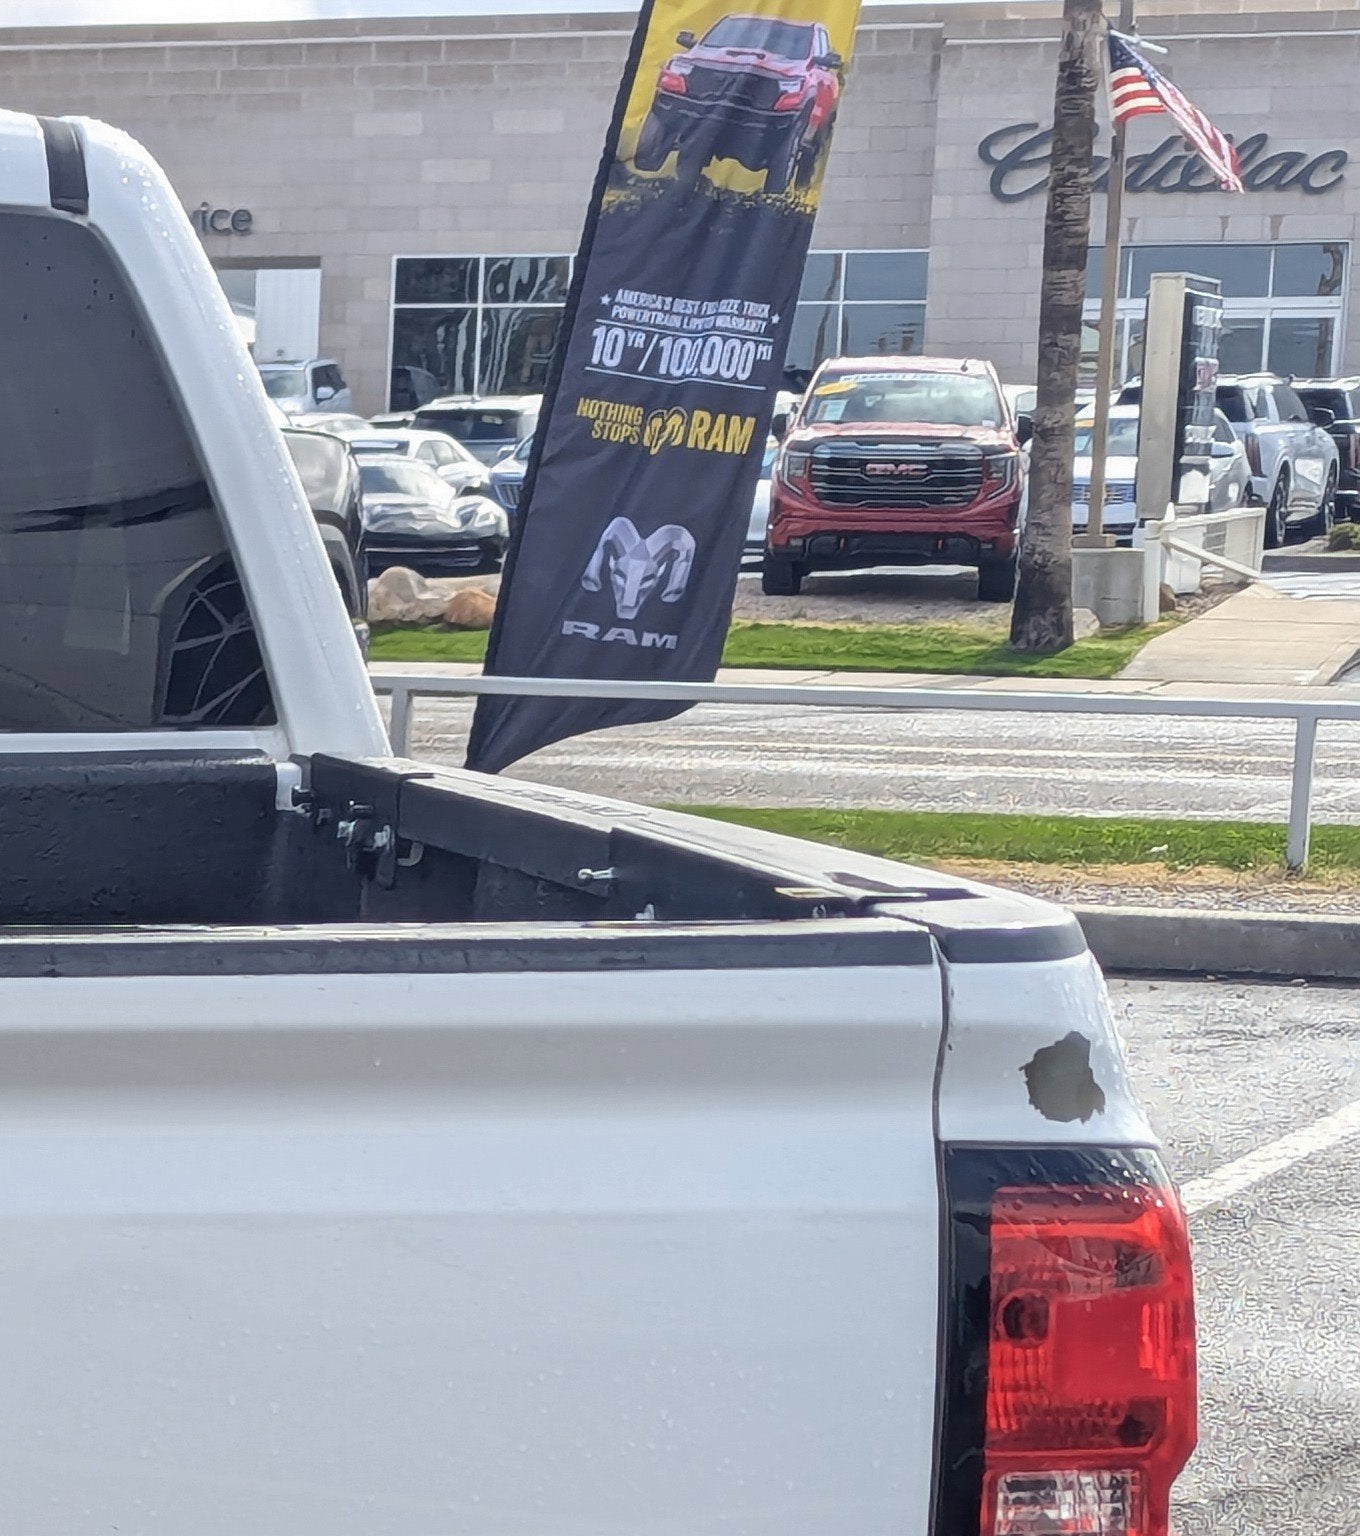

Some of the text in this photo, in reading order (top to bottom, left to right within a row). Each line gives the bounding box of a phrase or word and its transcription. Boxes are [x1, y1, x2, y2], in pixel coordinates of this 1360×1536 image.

[576, 397, 644, 424] NOTHING
[592, 420, 641, 445] STOPS
[687, 410, 756, 455] RAM
[561, 620, 678, 649] RAM
